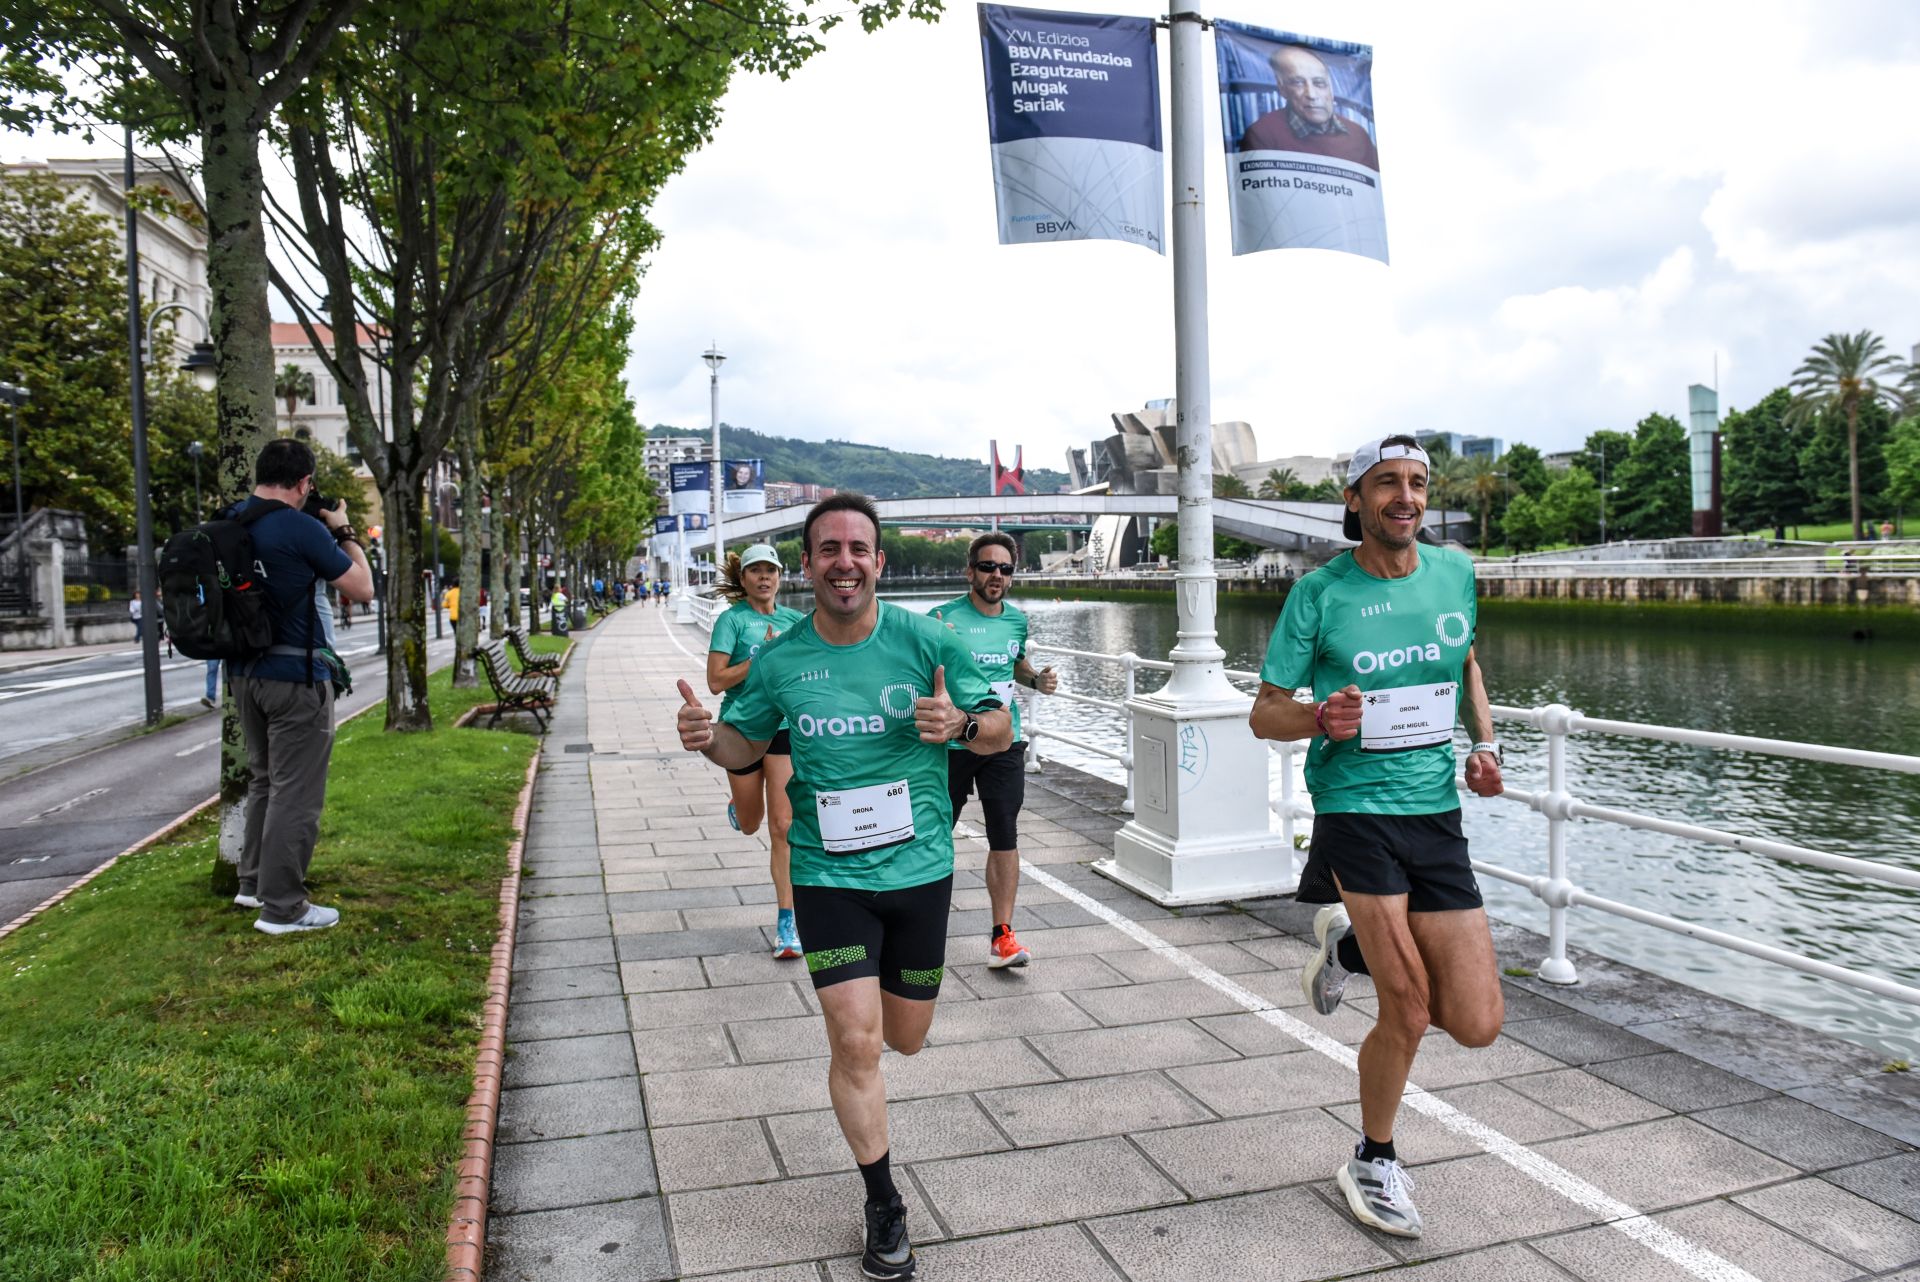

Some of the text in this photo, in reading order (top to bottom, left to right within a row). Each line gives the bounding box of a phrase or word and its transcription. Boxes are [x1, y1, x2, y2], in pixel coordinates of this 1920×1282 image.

[1006, 29, 1090, 47] XVI. Edizioa
[1008, 45, 1133, 68] BBVA Fundazioa
[1010, 62, 1109, 82] Ezagutzaren
[1012, 80, 1069, 96] Mugak
[1013, 98, 1066, 113] Sariak
[1242, 176, 1353, 197] Partha Dasgupta
[1036, 220, 1076, 234] BBVA
[1352, 642, 1441, 674] Orona
[1434, 687, 1451, 697] 680
[1399, 705, 1420, 713] ORONA
[798, 713, 886, 737] Orona
[1390, 721, 1430, 731] JOSE MIGUEL
[887, 787, 903, 797] 680
[852, 806, 874, 815] ORONA
[854, 823, 878, 832] XABIER
